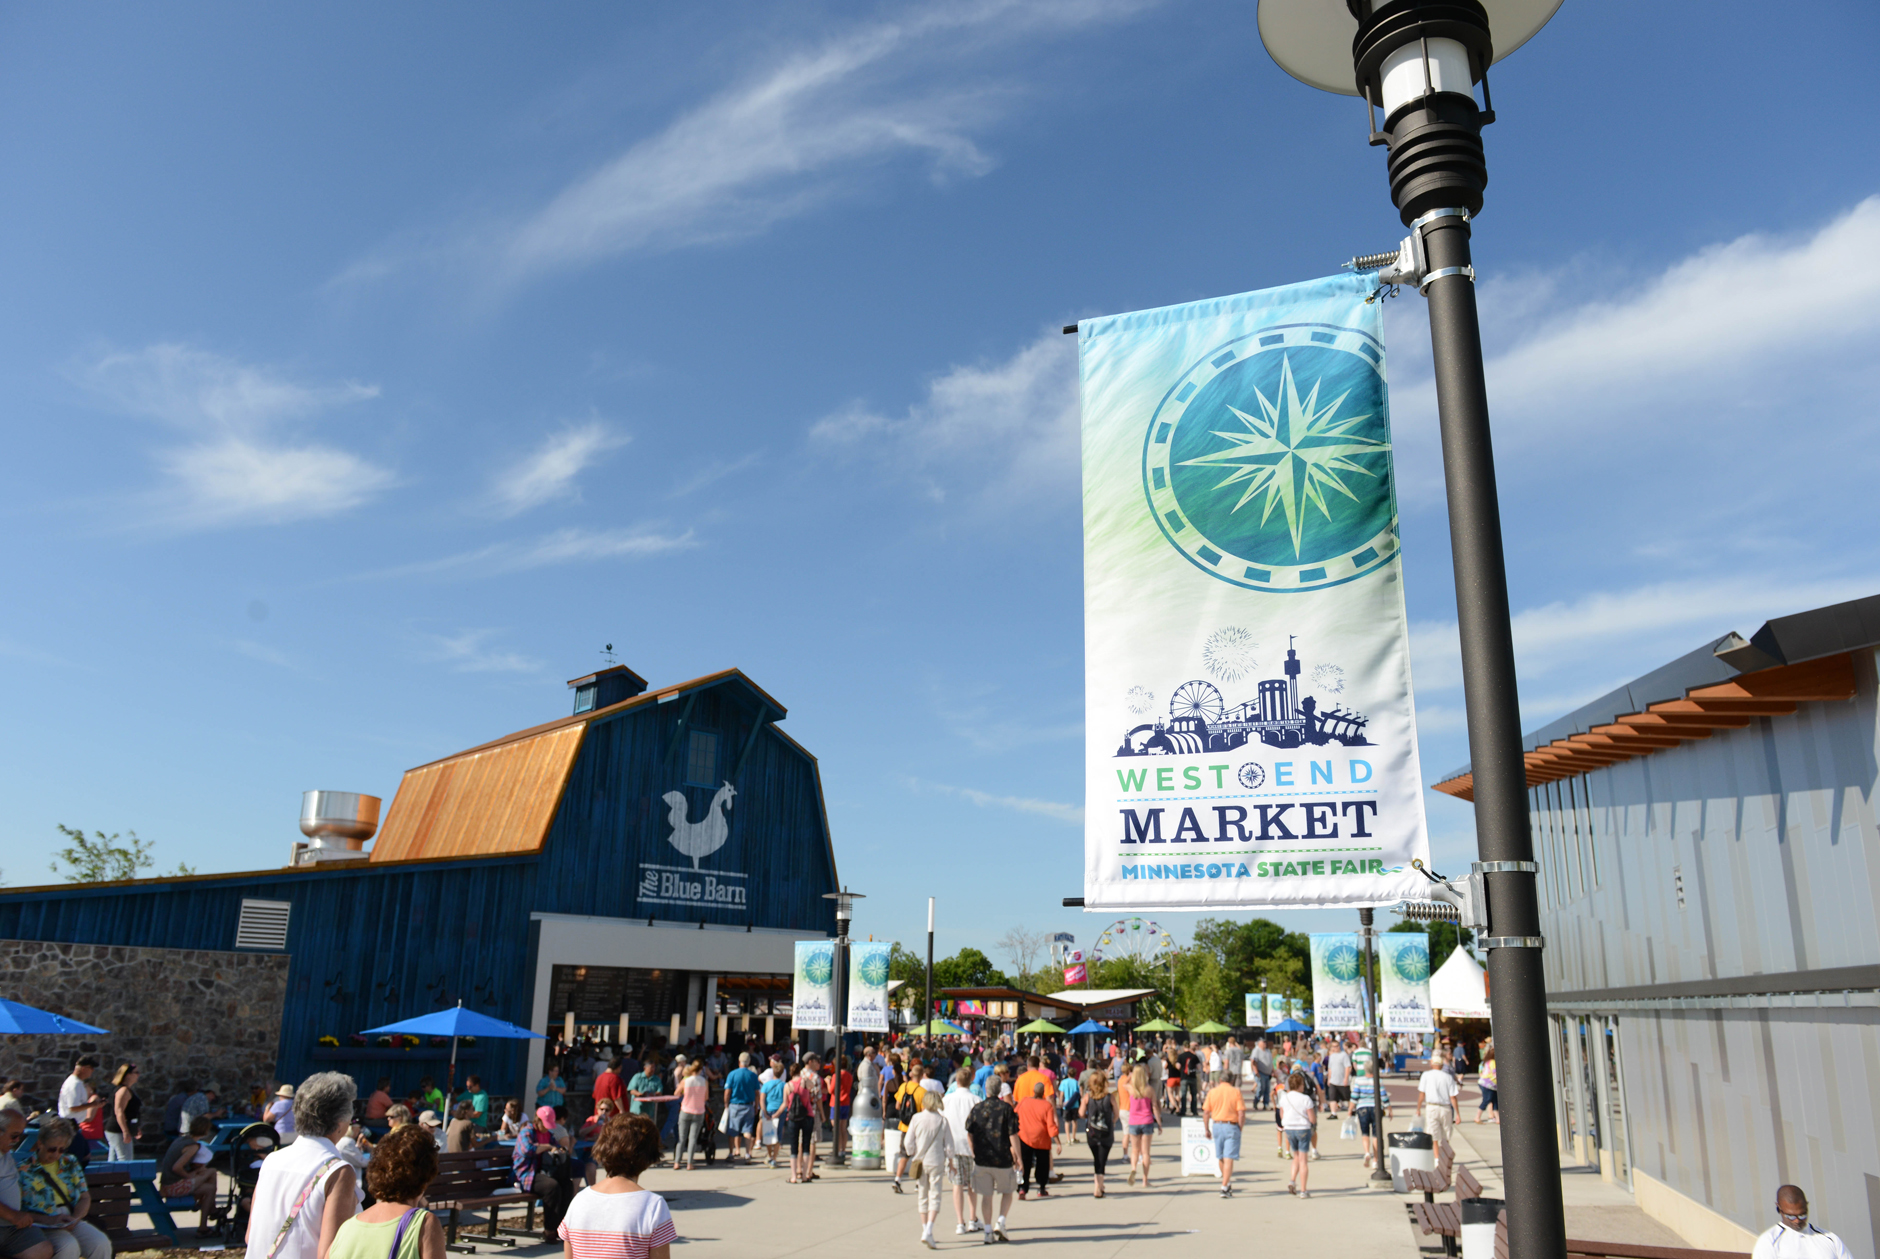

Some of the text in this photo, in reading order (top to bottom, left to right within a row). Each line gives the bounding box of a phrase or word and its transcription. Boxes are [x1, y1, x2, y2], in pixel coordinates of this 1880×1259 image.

[1116, 759, 1373, 792] WEST END
[1119, 800, 1378, 844] MARKET
[640, 870, 659, 897] The
[1121, 858, 1384, 881] MINNESOTA STATE FAIR
[660, 872, 746, 904] Blue Barn
